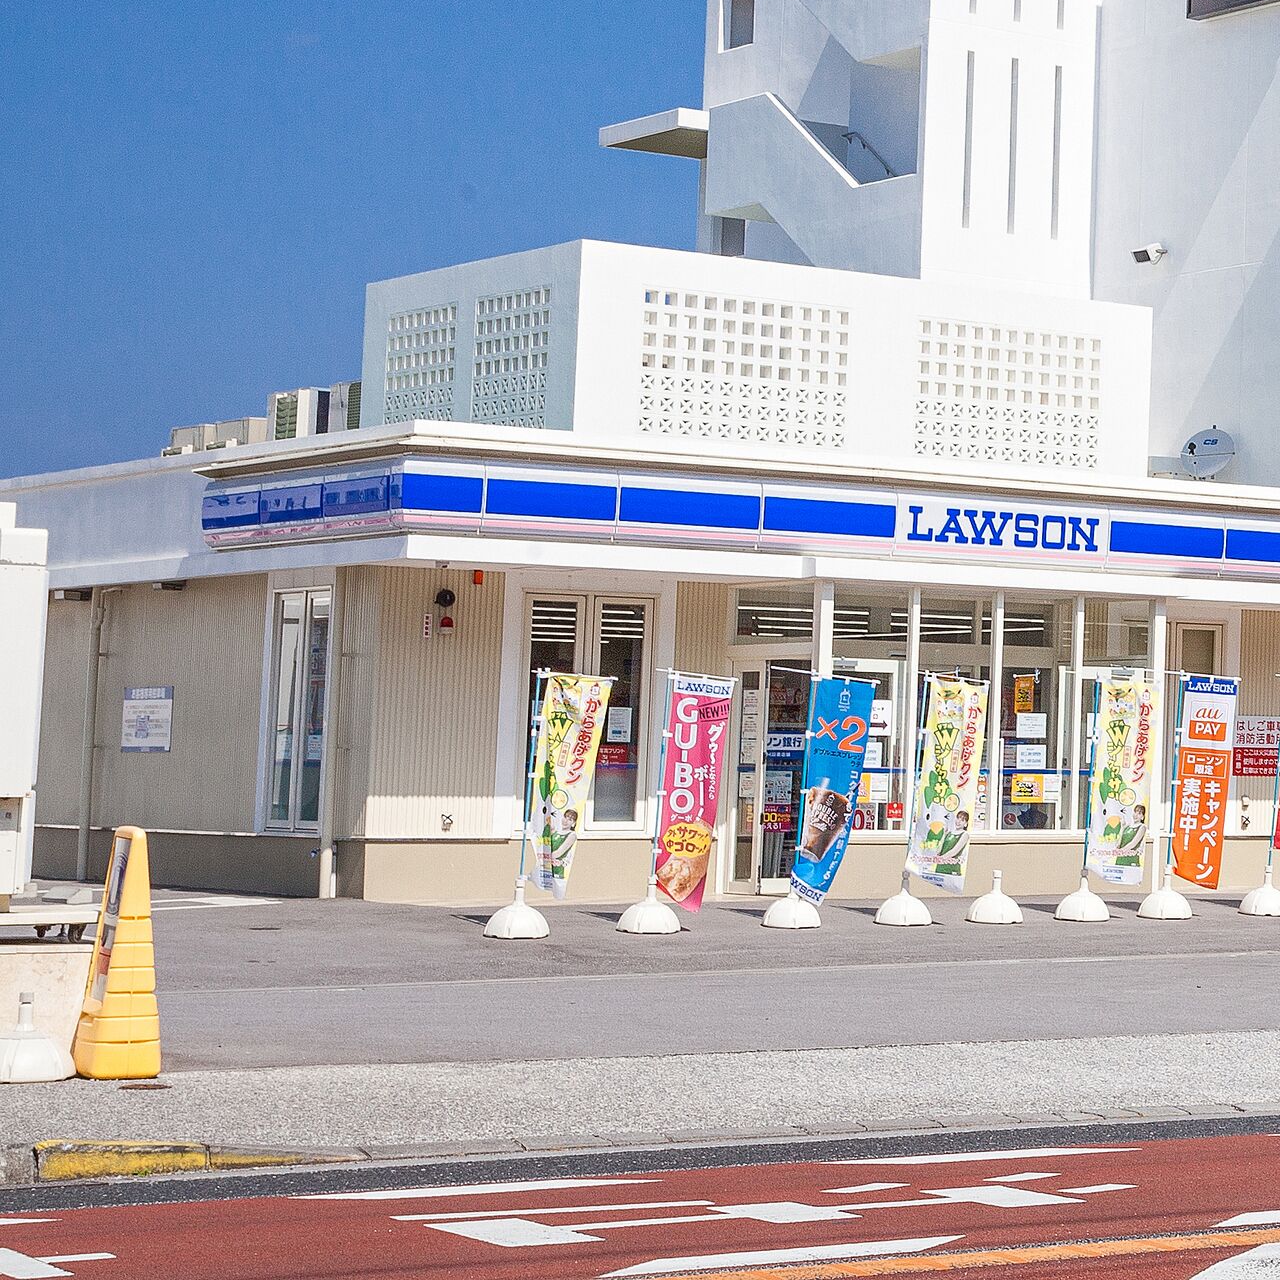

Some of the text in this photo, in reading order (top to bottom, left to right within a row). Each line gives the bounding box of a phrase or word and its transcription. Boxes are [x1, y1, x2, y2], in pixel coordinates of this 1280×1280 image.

[907, 506, 1099, 552] LAWSON
[677, 680, 730, 696] LAWSON
[1188, 681, 1235, 693] LAWSON
[699, 703, 730, 720] NEW!!!
[1195, 707, 1224, 721] au
[1195, 724, 1222, 736] PAY
[566, 698, 601, 785] からあげクン
[957, 706, 982, 788] からあげクン
[1132, 703, 1153, 783] からあげクン
[1187, 754, 1224, 765] ローソン
[1194, 764, 1214, 776] 限定
[1179, 778, 1201, 852] 実施中!
[1195, 780, 1222, 881] キャンペーン
[792, 876, 822, 902] WSON
